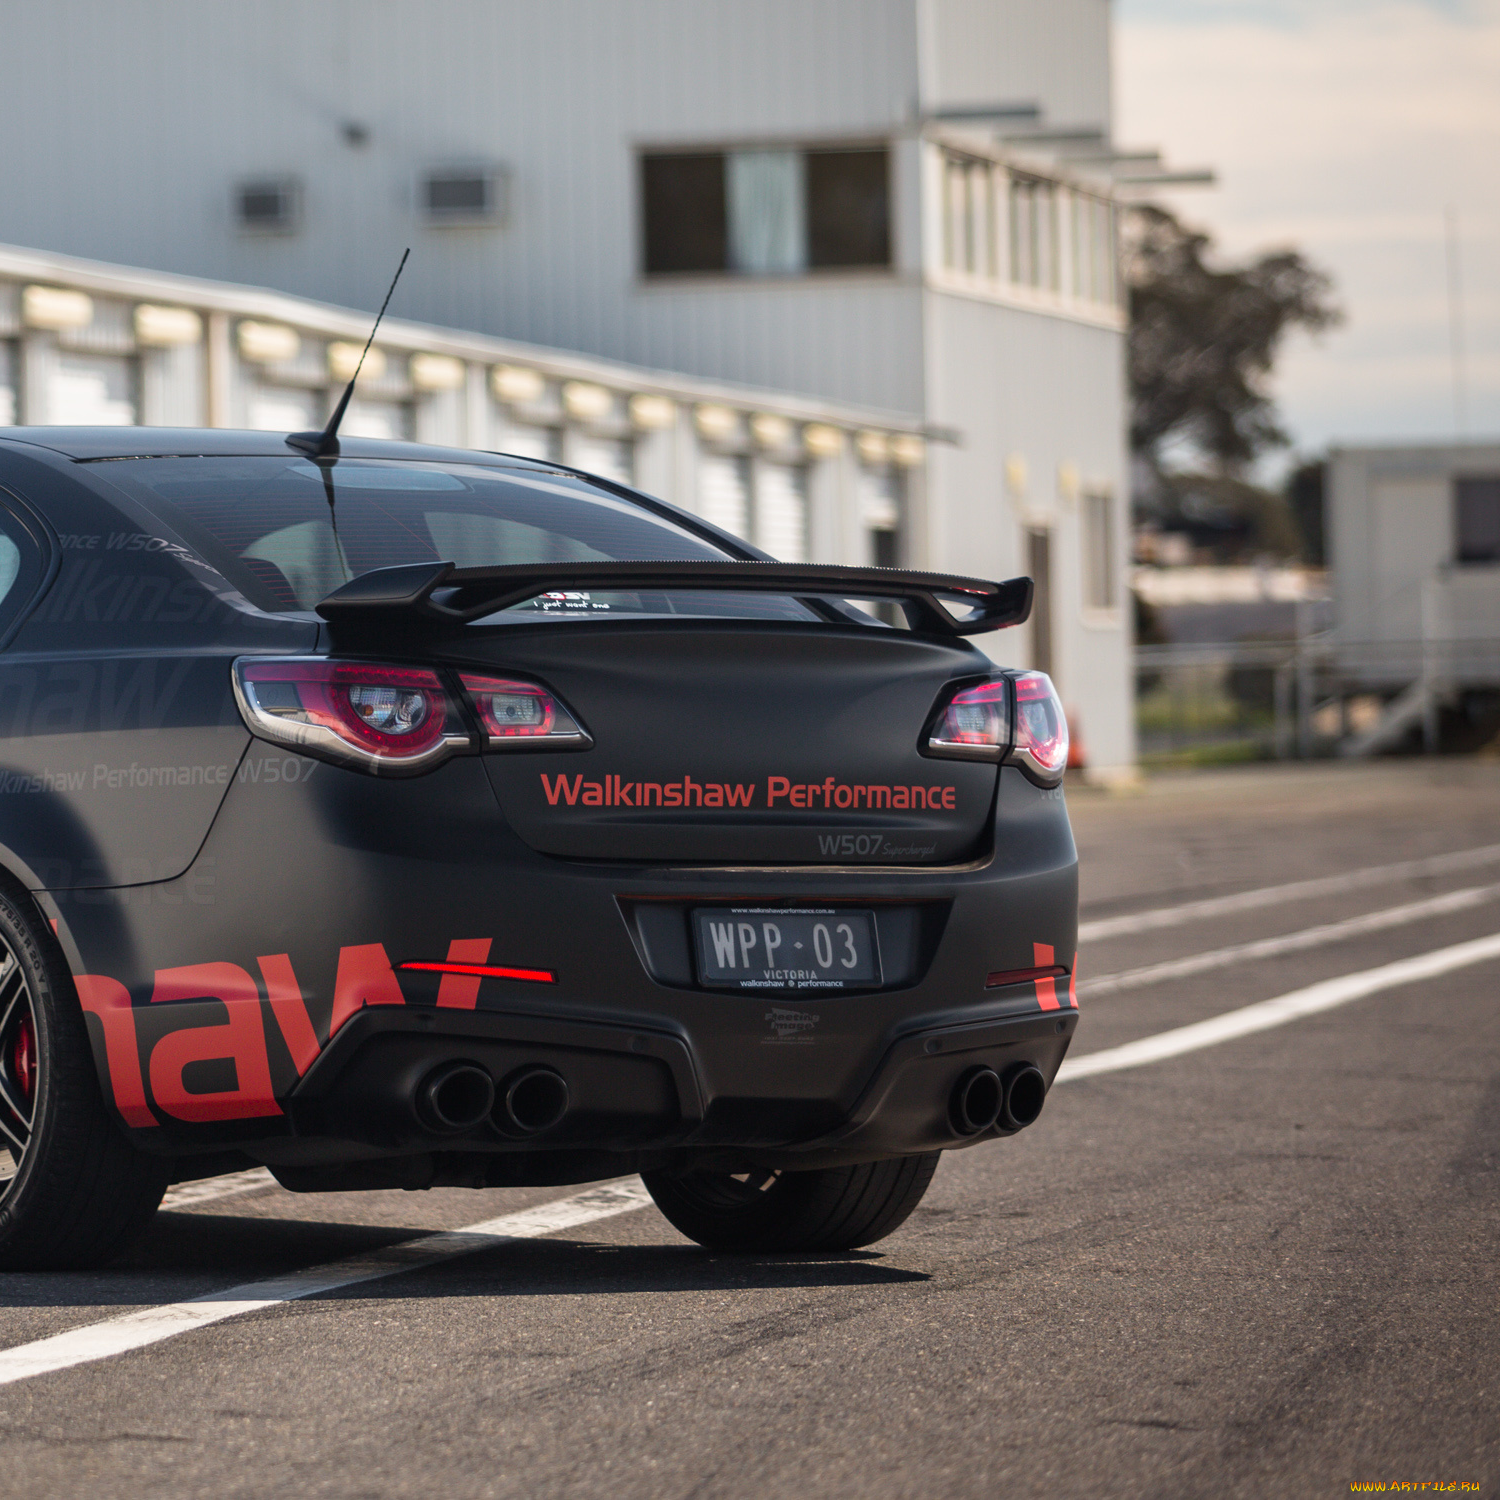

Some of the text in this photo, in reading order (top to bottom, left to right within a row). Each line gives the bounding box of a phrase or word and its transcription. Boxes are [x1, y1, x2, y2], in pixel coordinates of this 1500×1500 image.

[565, 600, 588, 609] want
[93, 761, 228, 790] Performance
[235, 757, 321, 783] W507
[540, 773, 957, 810] Walkinshaw Performance
[818, 834, 883, 855] W507
[763, 970, 818, 980] VICTORIA
[797, 980, 844, 989] performance
